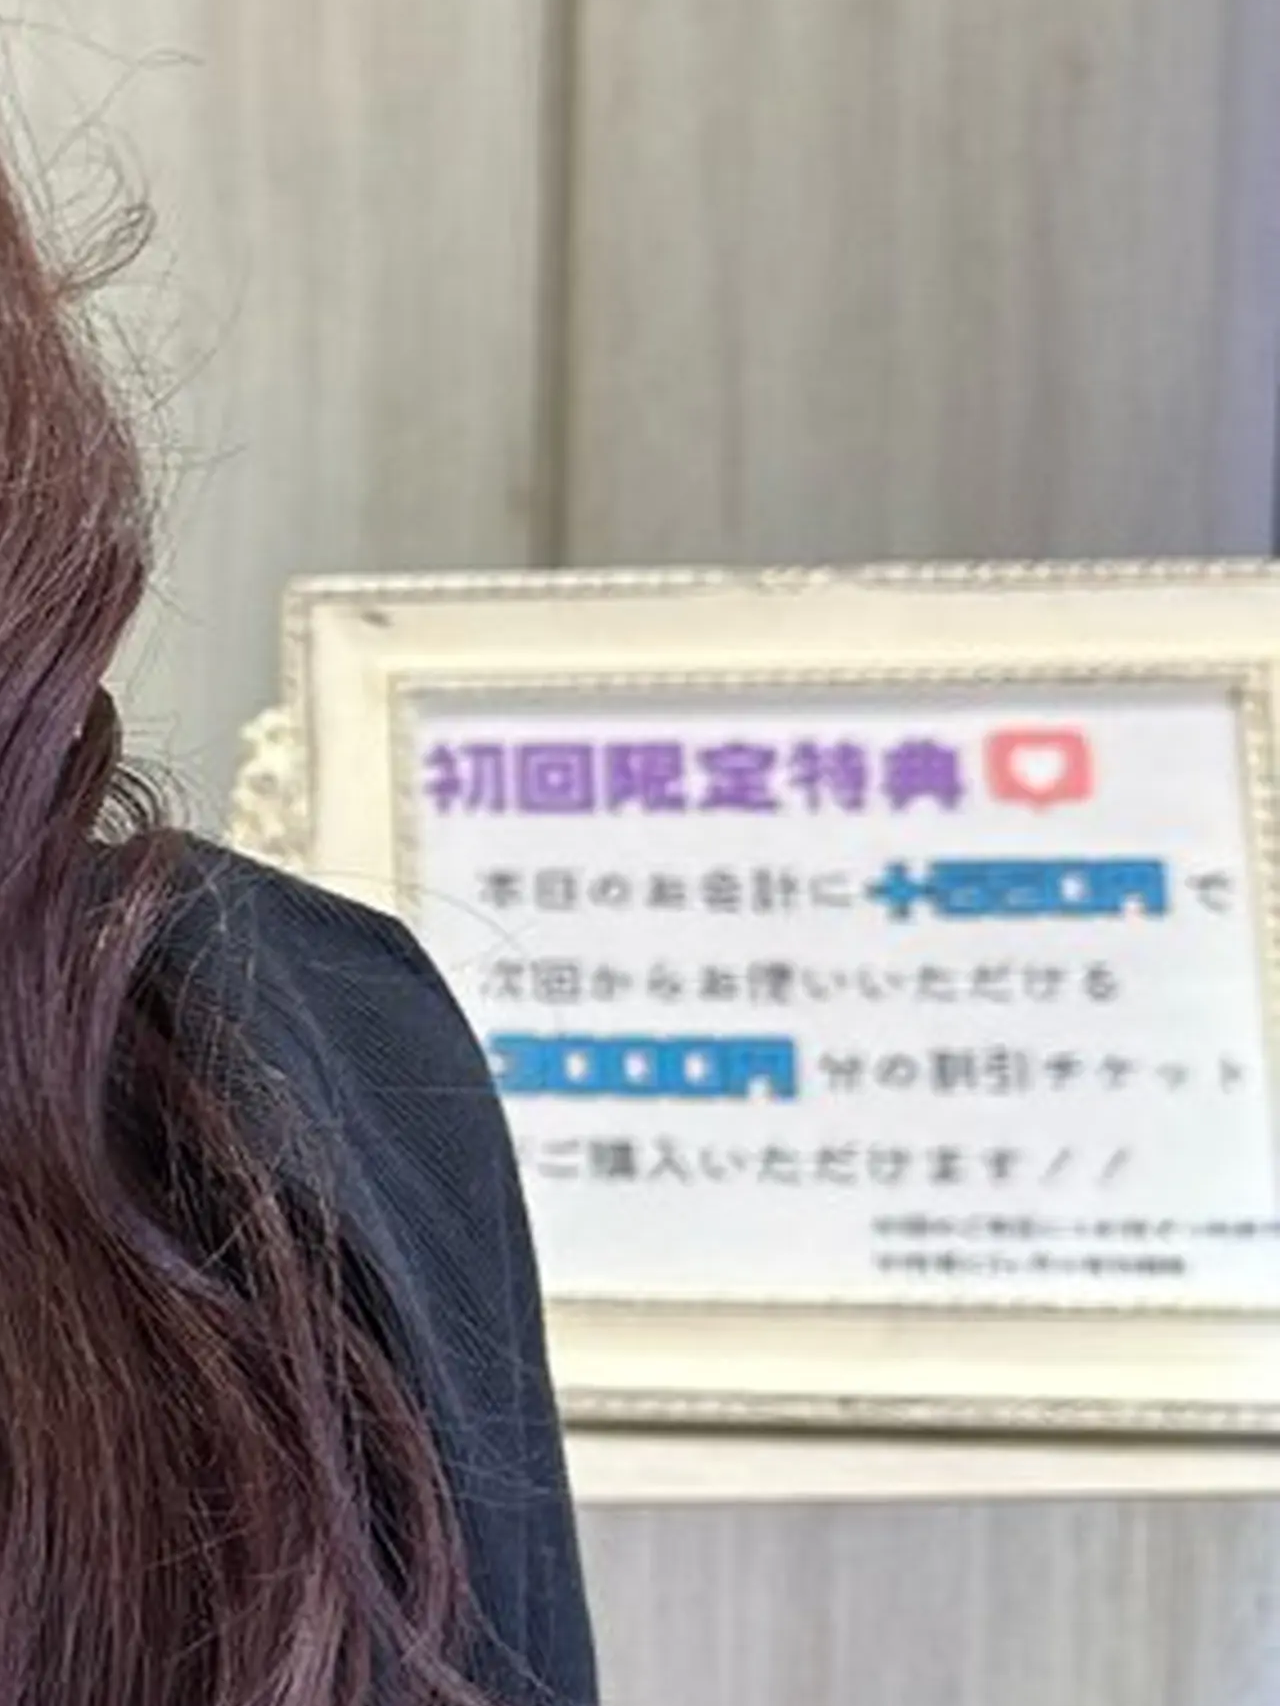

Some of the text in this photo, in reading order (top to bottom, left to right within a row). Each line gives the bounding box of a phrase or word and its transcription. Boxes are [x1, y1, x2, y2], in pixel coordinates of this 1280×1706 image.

[424, 740, 966, 815] 初回限定特典
